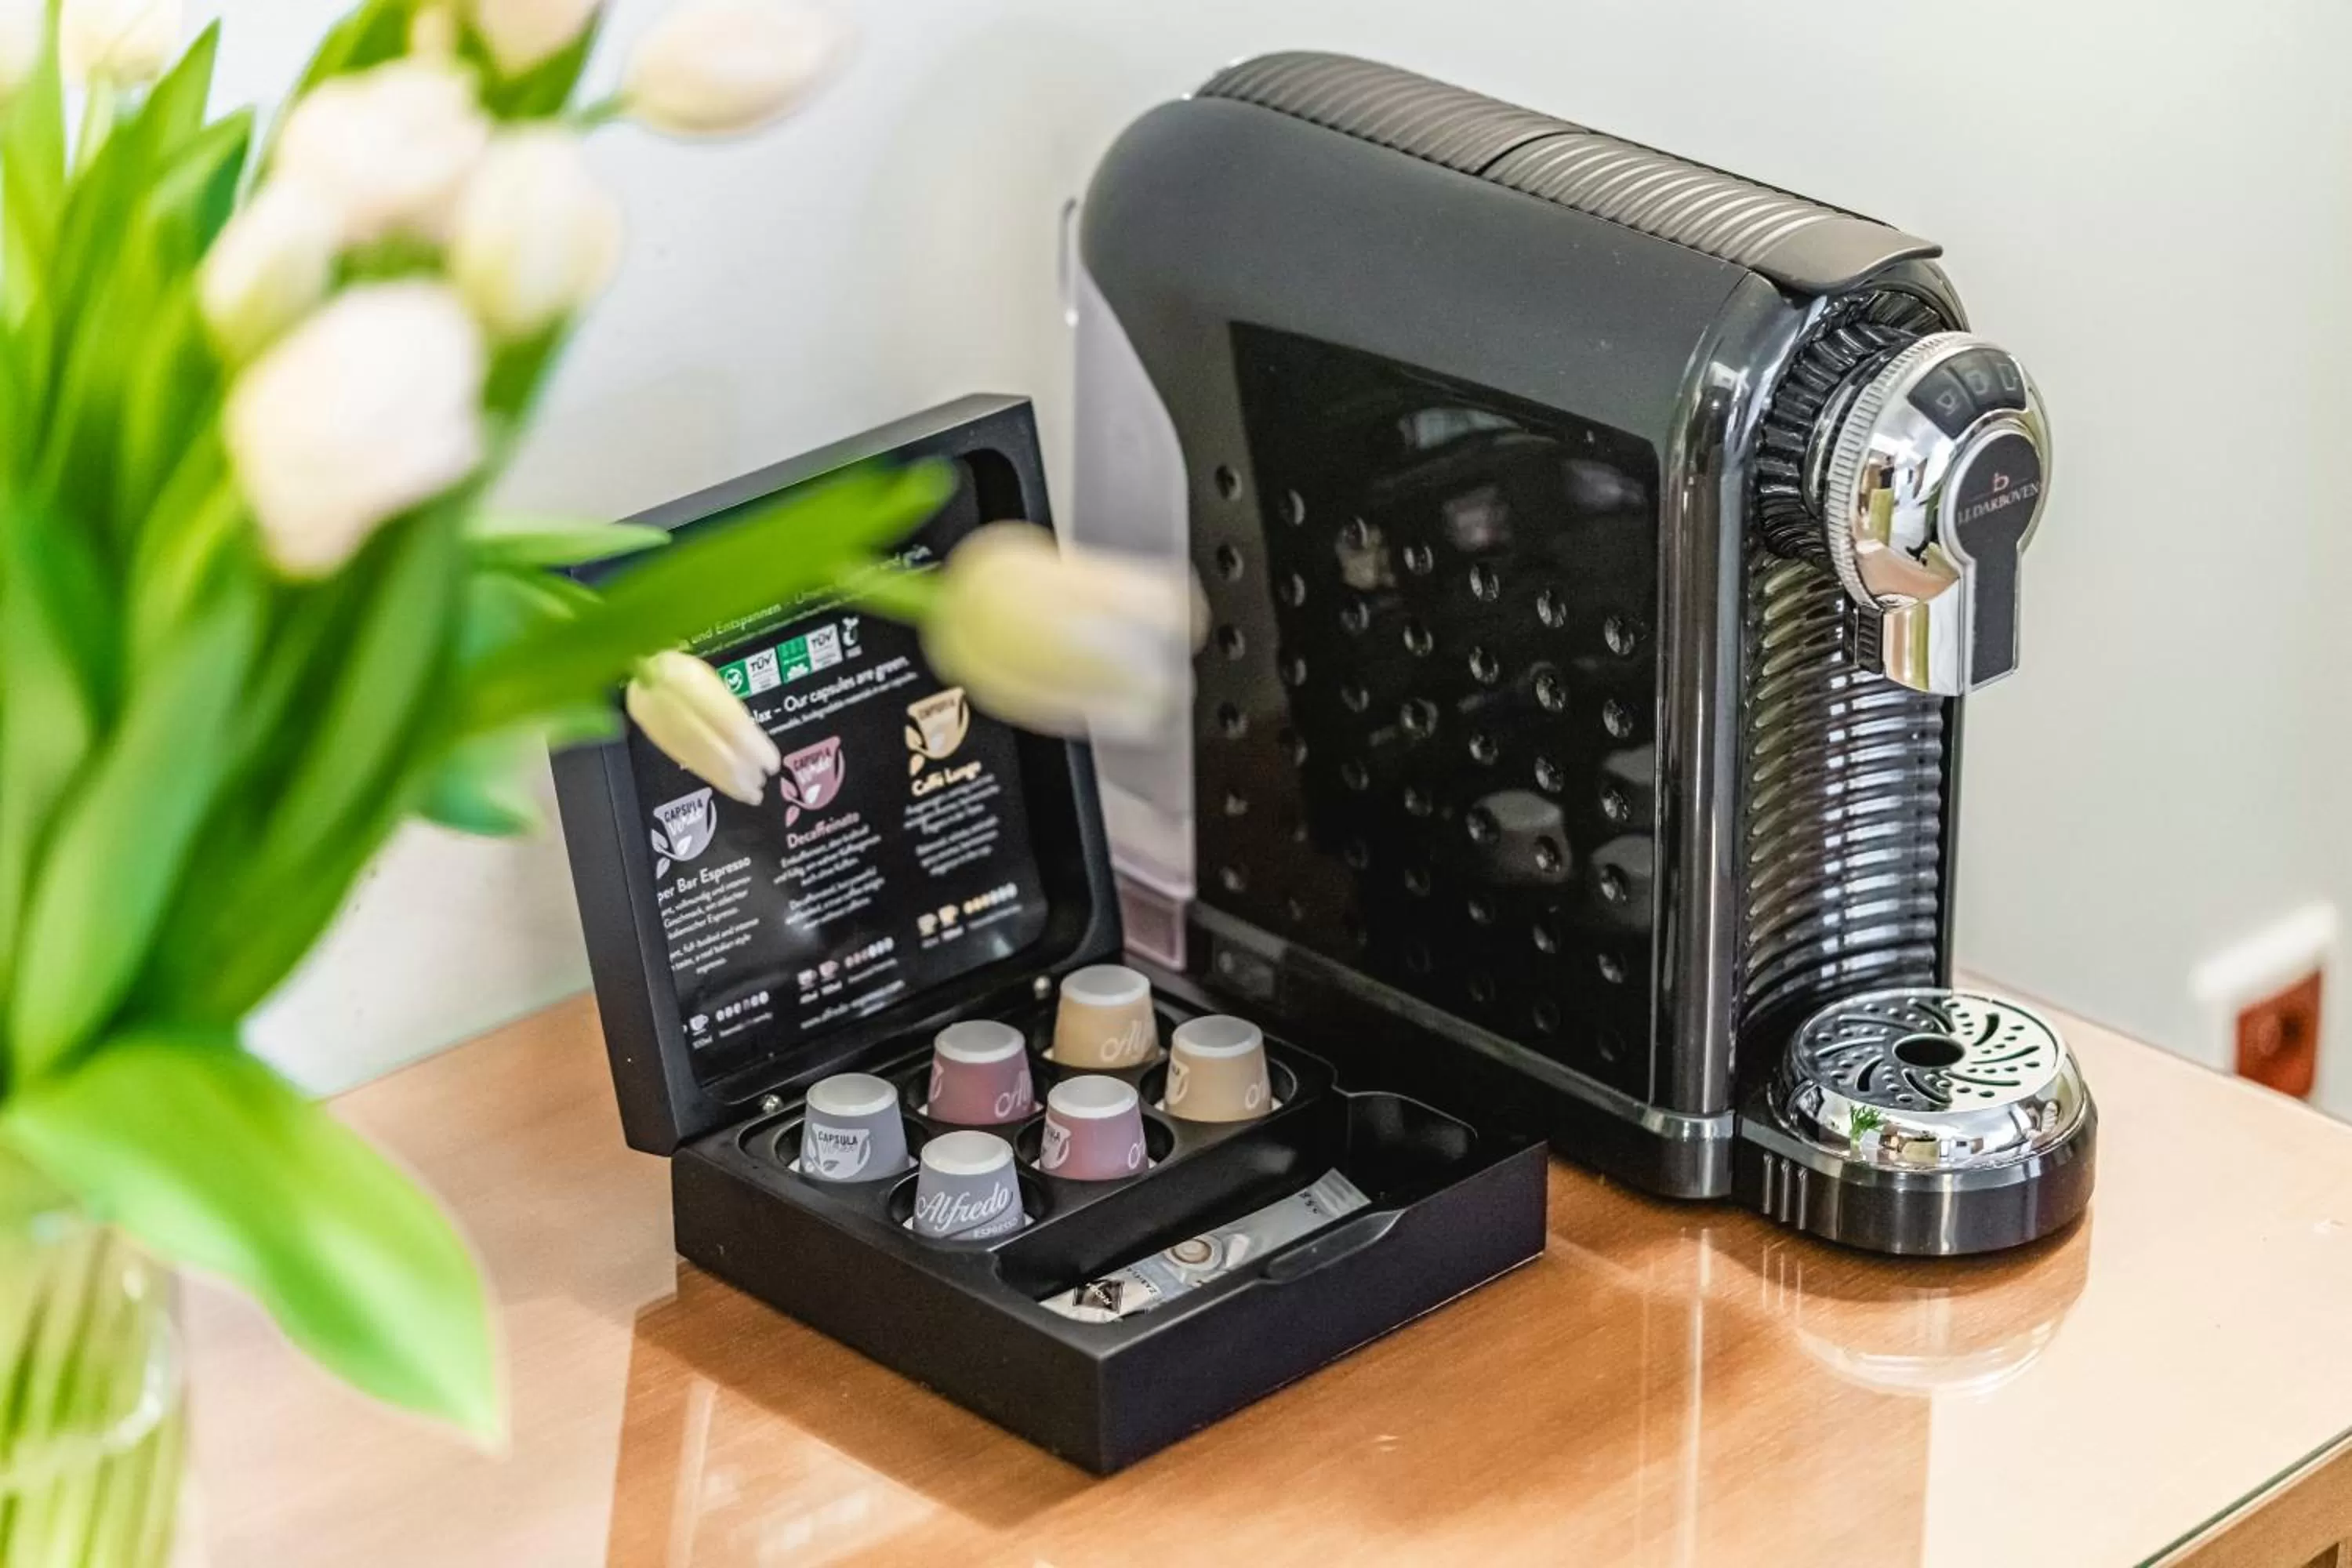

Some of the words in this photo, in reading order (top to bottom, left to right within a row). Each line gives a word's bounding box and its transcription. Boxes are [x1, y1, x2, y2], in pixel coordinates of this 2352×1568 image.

[750, 653, 774, 673] TÜV
[783, 693, 809, 713] Our
[809, 676, 856, 705] capsules
[856, 668, 874, 684] are
[664, 797, 703, 823] CAPSULA
[677, 877, 699, 894] Bar
[699, 856, 752, 884] Espresso
[818, 1130, 859, 1146] CAPSULA
[916, 1181, 1009, 1232] Alfredo
